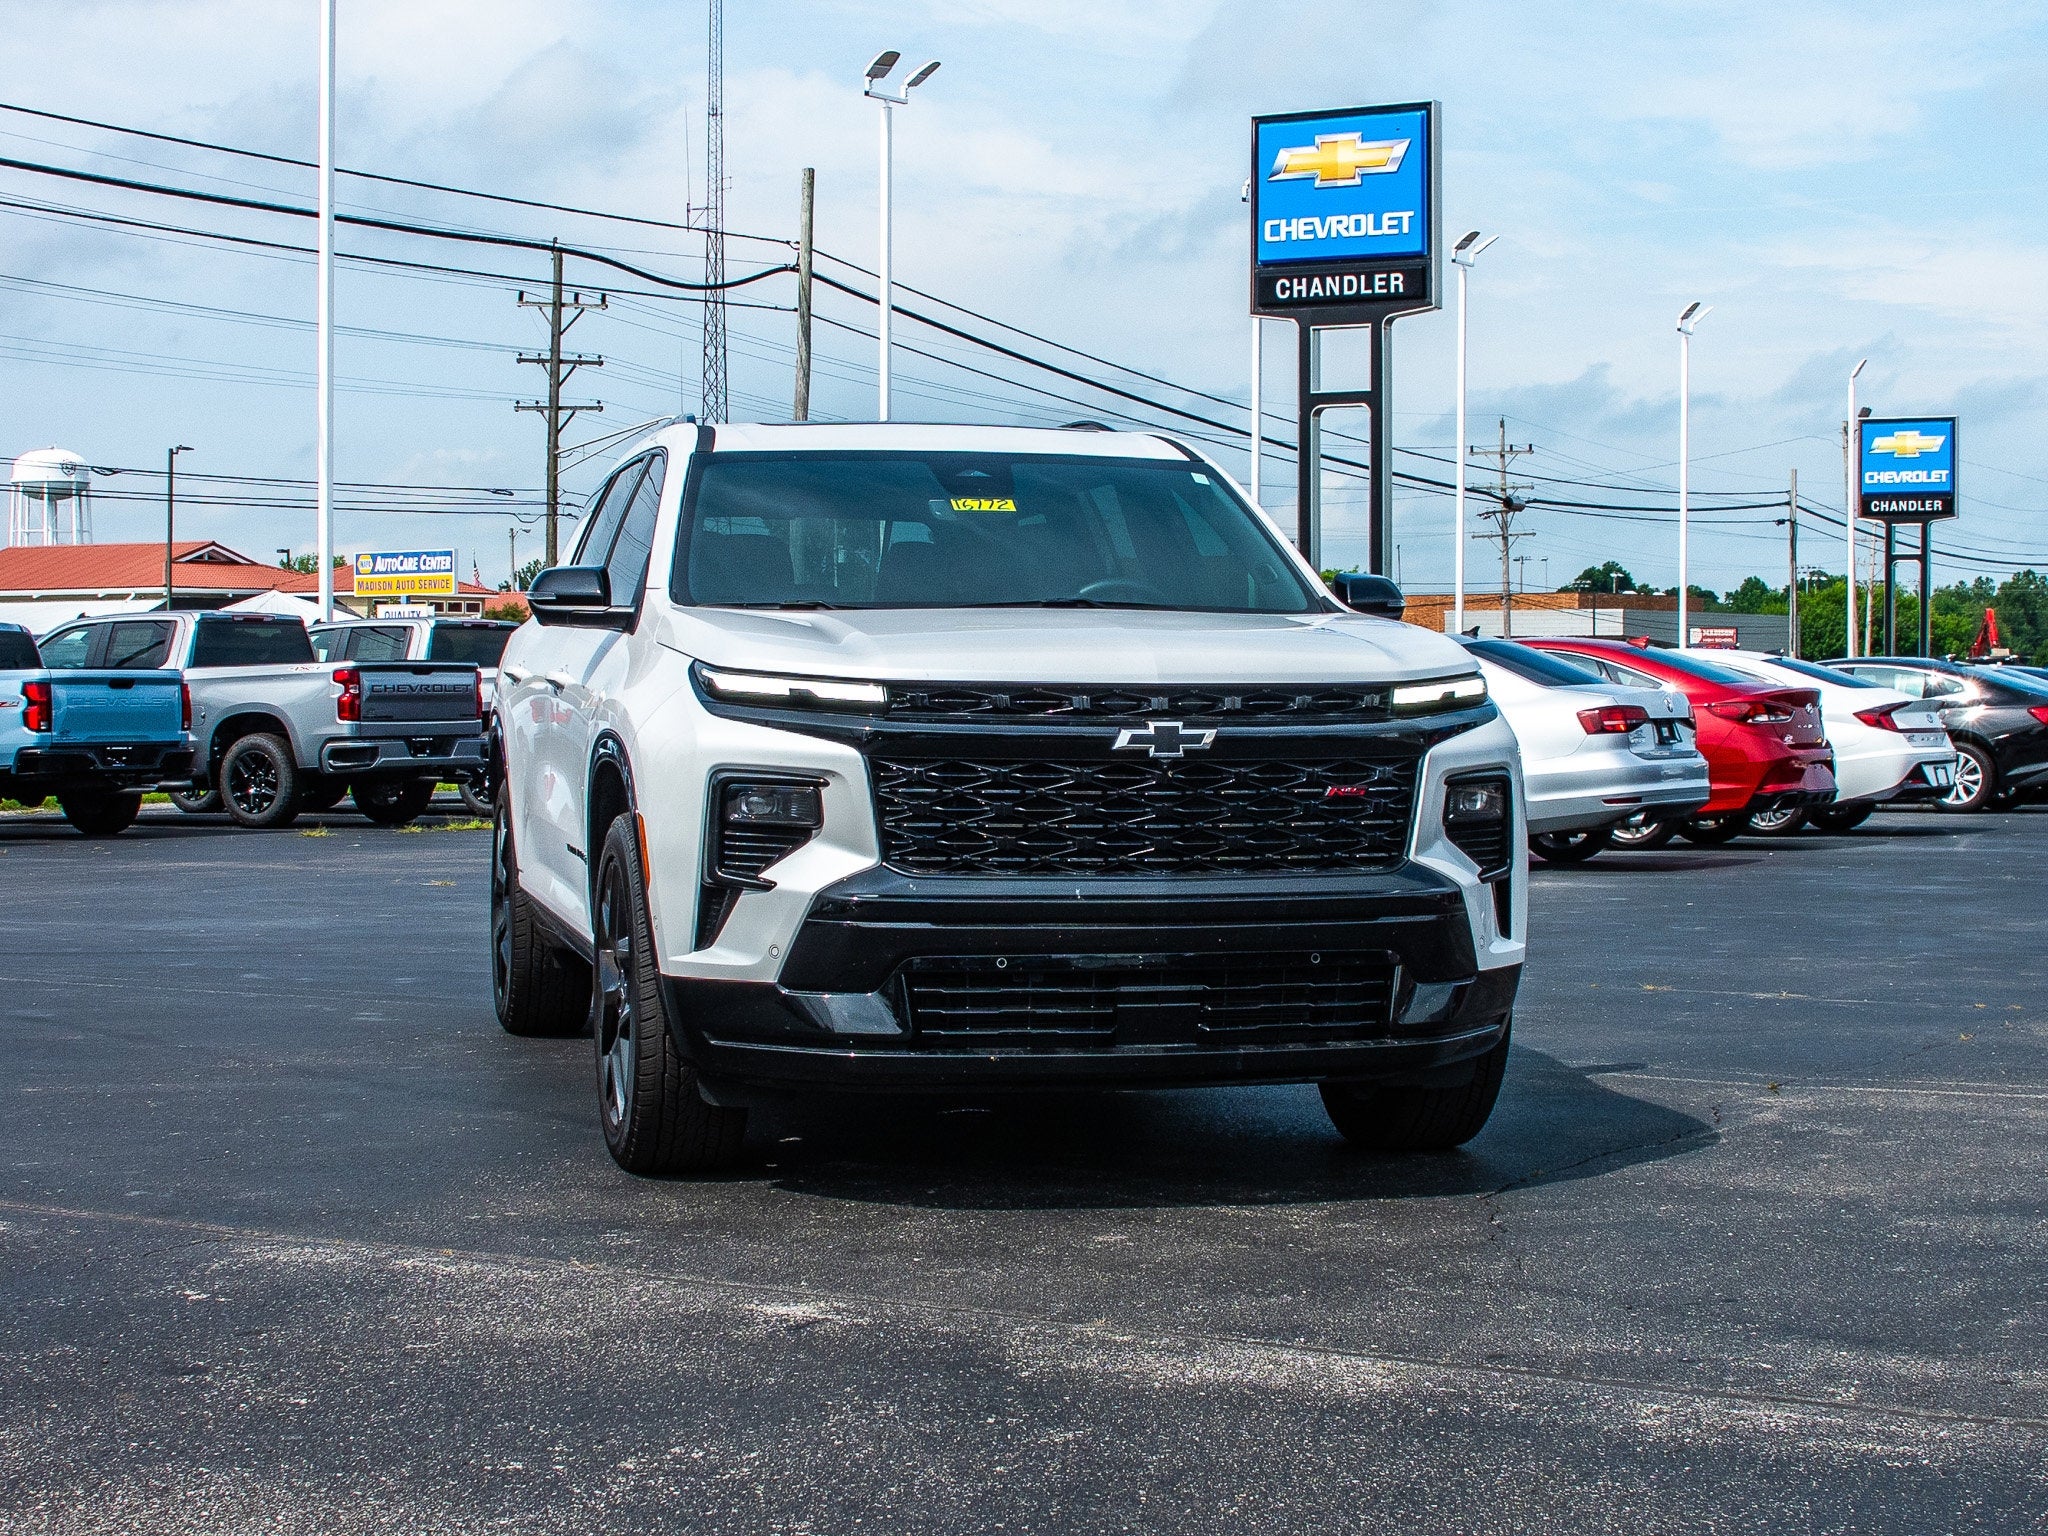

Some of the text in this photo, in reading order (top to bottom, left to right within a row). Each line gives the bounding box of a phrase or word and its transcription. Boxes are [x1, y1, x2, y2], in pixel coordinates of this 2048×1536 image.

[1264, 210, 1415, 242] CHEVROLET
[1275, 272, 1404, 299] CHANDLER
[1864, 469, 1950, 484] CHEVROLET
[1870, 500, 1943, 512] CHANDLER
[420, 554, 452, 571] CENTER
[357, 578, 450, 592] MADISON AUTO SERVICE
[371, 684, 472, 694] CHEVROLET
